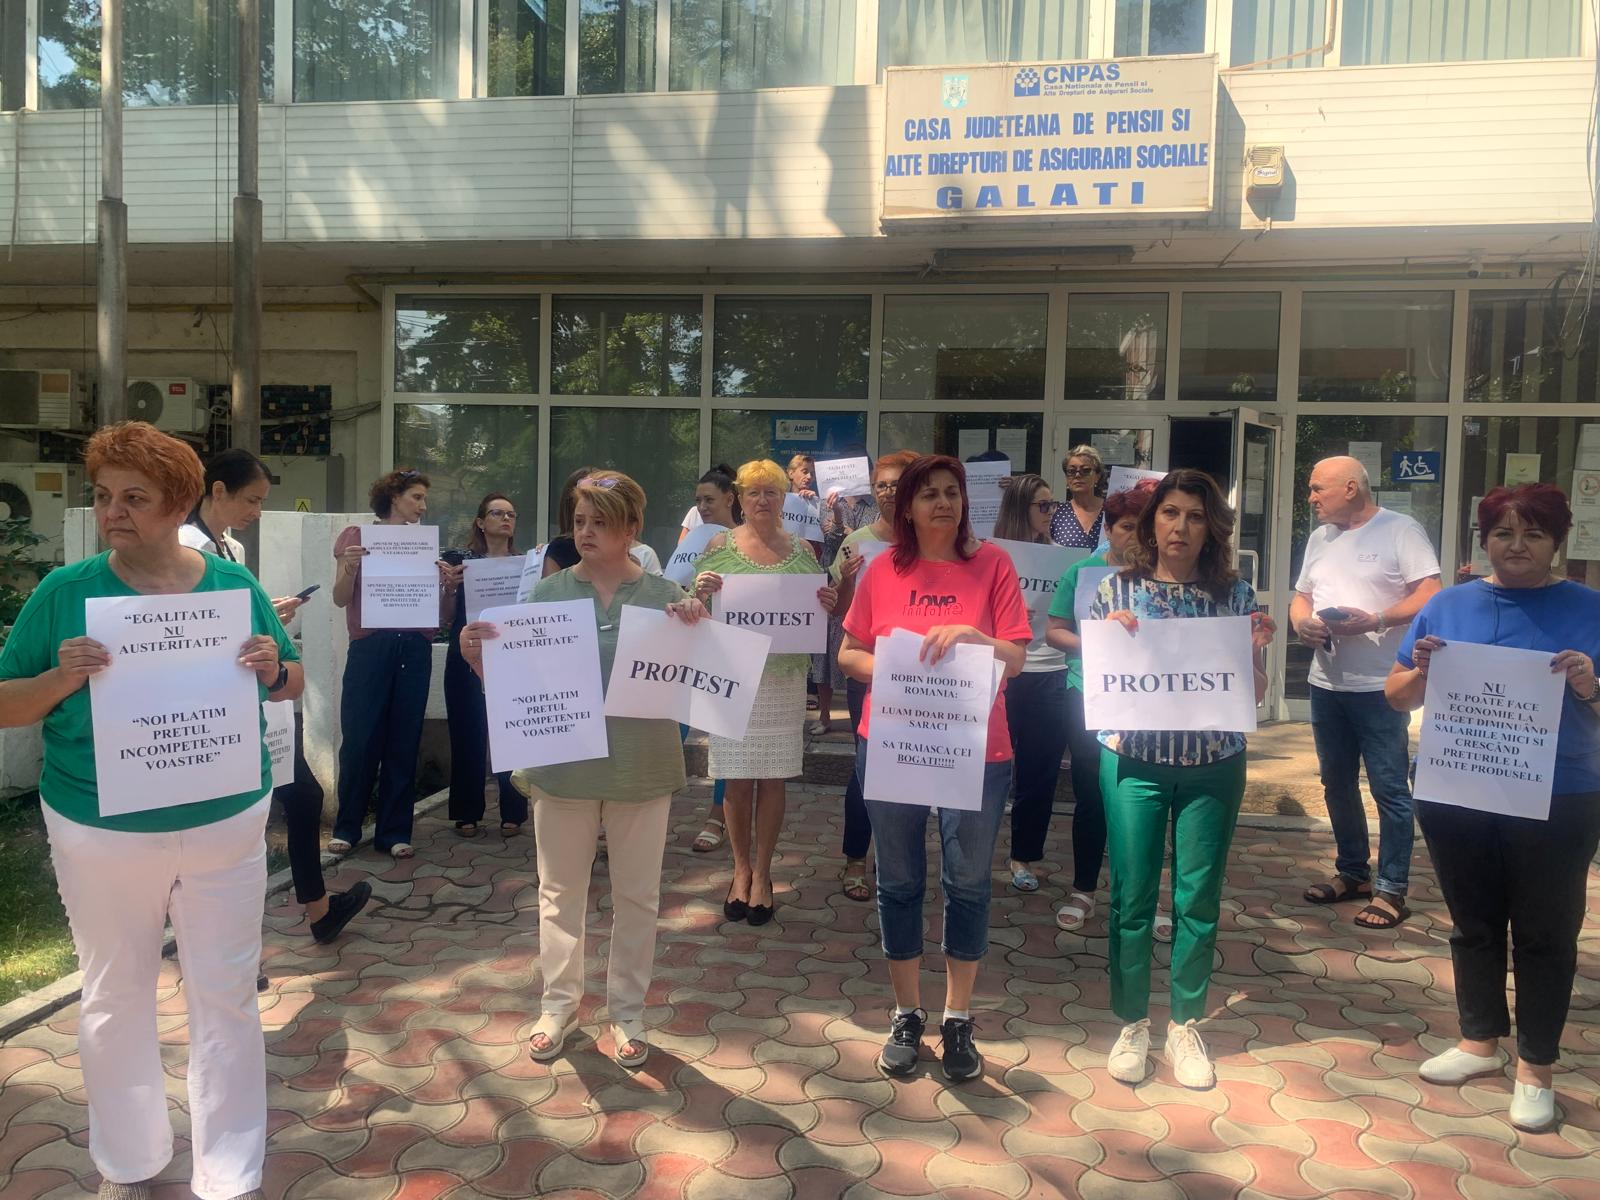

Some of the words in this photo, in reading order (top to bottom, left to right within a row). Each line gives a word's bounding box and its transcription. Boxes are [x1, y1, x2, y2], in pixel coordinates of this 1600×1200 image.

[1044, 64, 1120, 84] CNPAS
[1059, 88, 1085, 96] Drepturi
[1099, 87, 1128, 96] Asigurari
[1130, 86, 1154, 94] Sociale
[1066, 82, 1102, 90] Nationala
[904, 118, 951, 142] CASA
[964, 114, 1060, 139] JUDETEANA
[1073, 112, 1094, 135] DE
[1106, 108, 1164, 134] PENSII
[1172, 108, 1190, 131] SI
[886, 154, 922, 176] ALTE
[928, 150, 1008, 176] DREPTURI
[1012, 149, 1033, 172] DE
[1039, 146, 1132, 171] ASIGURARI
[1136, 142, 1208, 168] SOCIALE
[910, 590, 956, 608] Love
[726, 611, 815, 626] PROTEST
[164, 626, 184, 637] NU
[532, 628, 546, 636] NU
[119, 636, 228, 655] AUSTERITATE”
[502, 636, 579, 650] AUSTERITATE”
[630, 660, 740, 700] PROTEST
[890, 673, 924, 684] ROBIN
[926, 676, 958, 687] HOOD
[960, 680, 974, 689] DE
[1102, 672, 1235, 693] PROTEST
[1483, 682, 1506, 694] NU
[512, 692, 537, 705] “NOI
[539, 690, 580, 702] PLATIM
[904, 686, 958, 699] ROMANIA:
[527, 703, 568, 715] PRETUL
[1448, 692, 1461, 702] SE
[1464, 694, 1504, 706] POATE
[1507, 700, 1540, 712] FACE
[132, 714, 168, 728] “NOI
[172, 708, 226, 723] PLATIM
[505, 711, 591, 730] INCOMPETENTEI
[882, 706, 912, 717] LUAM
[914, 710, 945, 720] DOAR
[948, 712, 961, 722] DE
[964, 714, 978, 723] LA
[1434, 712, 1474, 724] BUGET
[1450, 704, 1515, 720] ECONOMIE
[1518, 713, 1534, 722] LA
[153, 726, 211, 740] PRETUL
[522, 724, 576, 738] VOASTRE”
[909, 720, 948, 732] SARACI
[1434, 724, 1498, 740] SALARIILE
[1501, 733, 1530, 744] MICI
[1532, 738, 1544, 747] SI
[120, 734, 242, 760] INCOMPETENTEI
[882, 740, 896, 750] SA
[898, 742, 950, 756] TRAIASCA
[953, 747, 972, 758] CEI
[146, 752, 221, 771] VOASTRE”
[1443, 747, 1510, 766] PRETURILE
[1513, 759, 1530, 769] LA
[1429, 757, 1468, 771] TOATE
[1470, 764, 1544, 782] PRODUSELE
